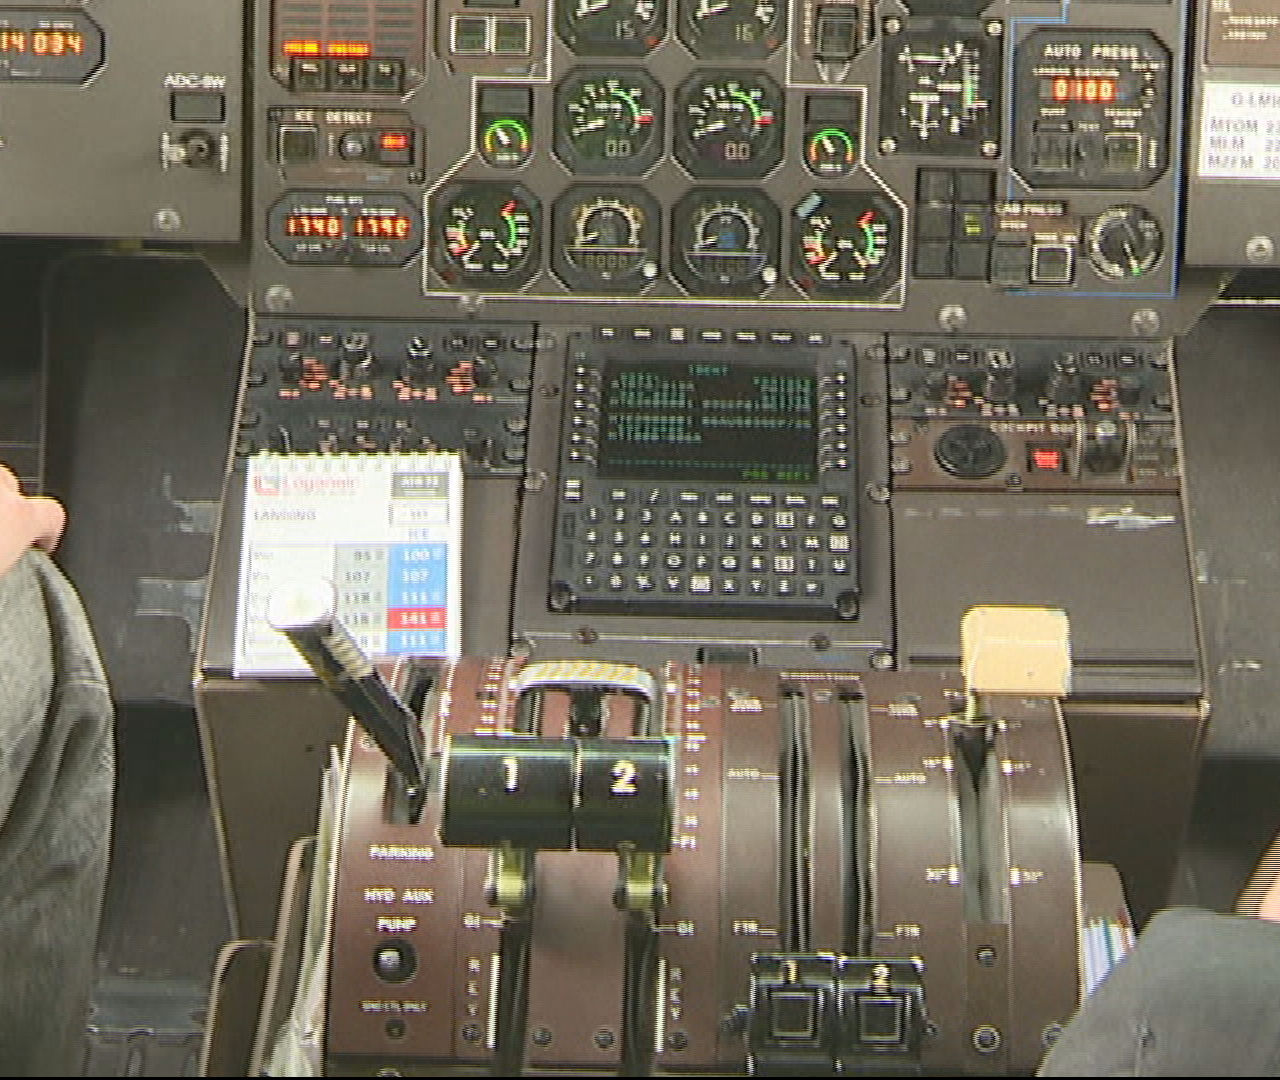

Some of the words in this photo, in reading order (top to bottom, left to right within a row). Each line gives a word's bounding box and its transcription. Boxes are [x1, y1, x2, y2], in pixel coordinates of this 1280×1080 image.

[0, 31, 26, 53] 14
[1044, 45, 1082, 58] AUTO
[1092, 45, 1138, 59] PRESS
[325, 111, 372, 124] DETECT
[254, 511, 317, 521] LANDING
[503, 756, 517, 792] 1
[610, 759, 638, 796] 2
[894, 773, 927, 785] AUTO
[369, 844, 435, 861] PARKING
[364, 887, 395, 903] HYD
[402, 888, 435, 904] AUX
[376, 916, 417, 932] PUMP
[786, 959, 798, 983] 1
